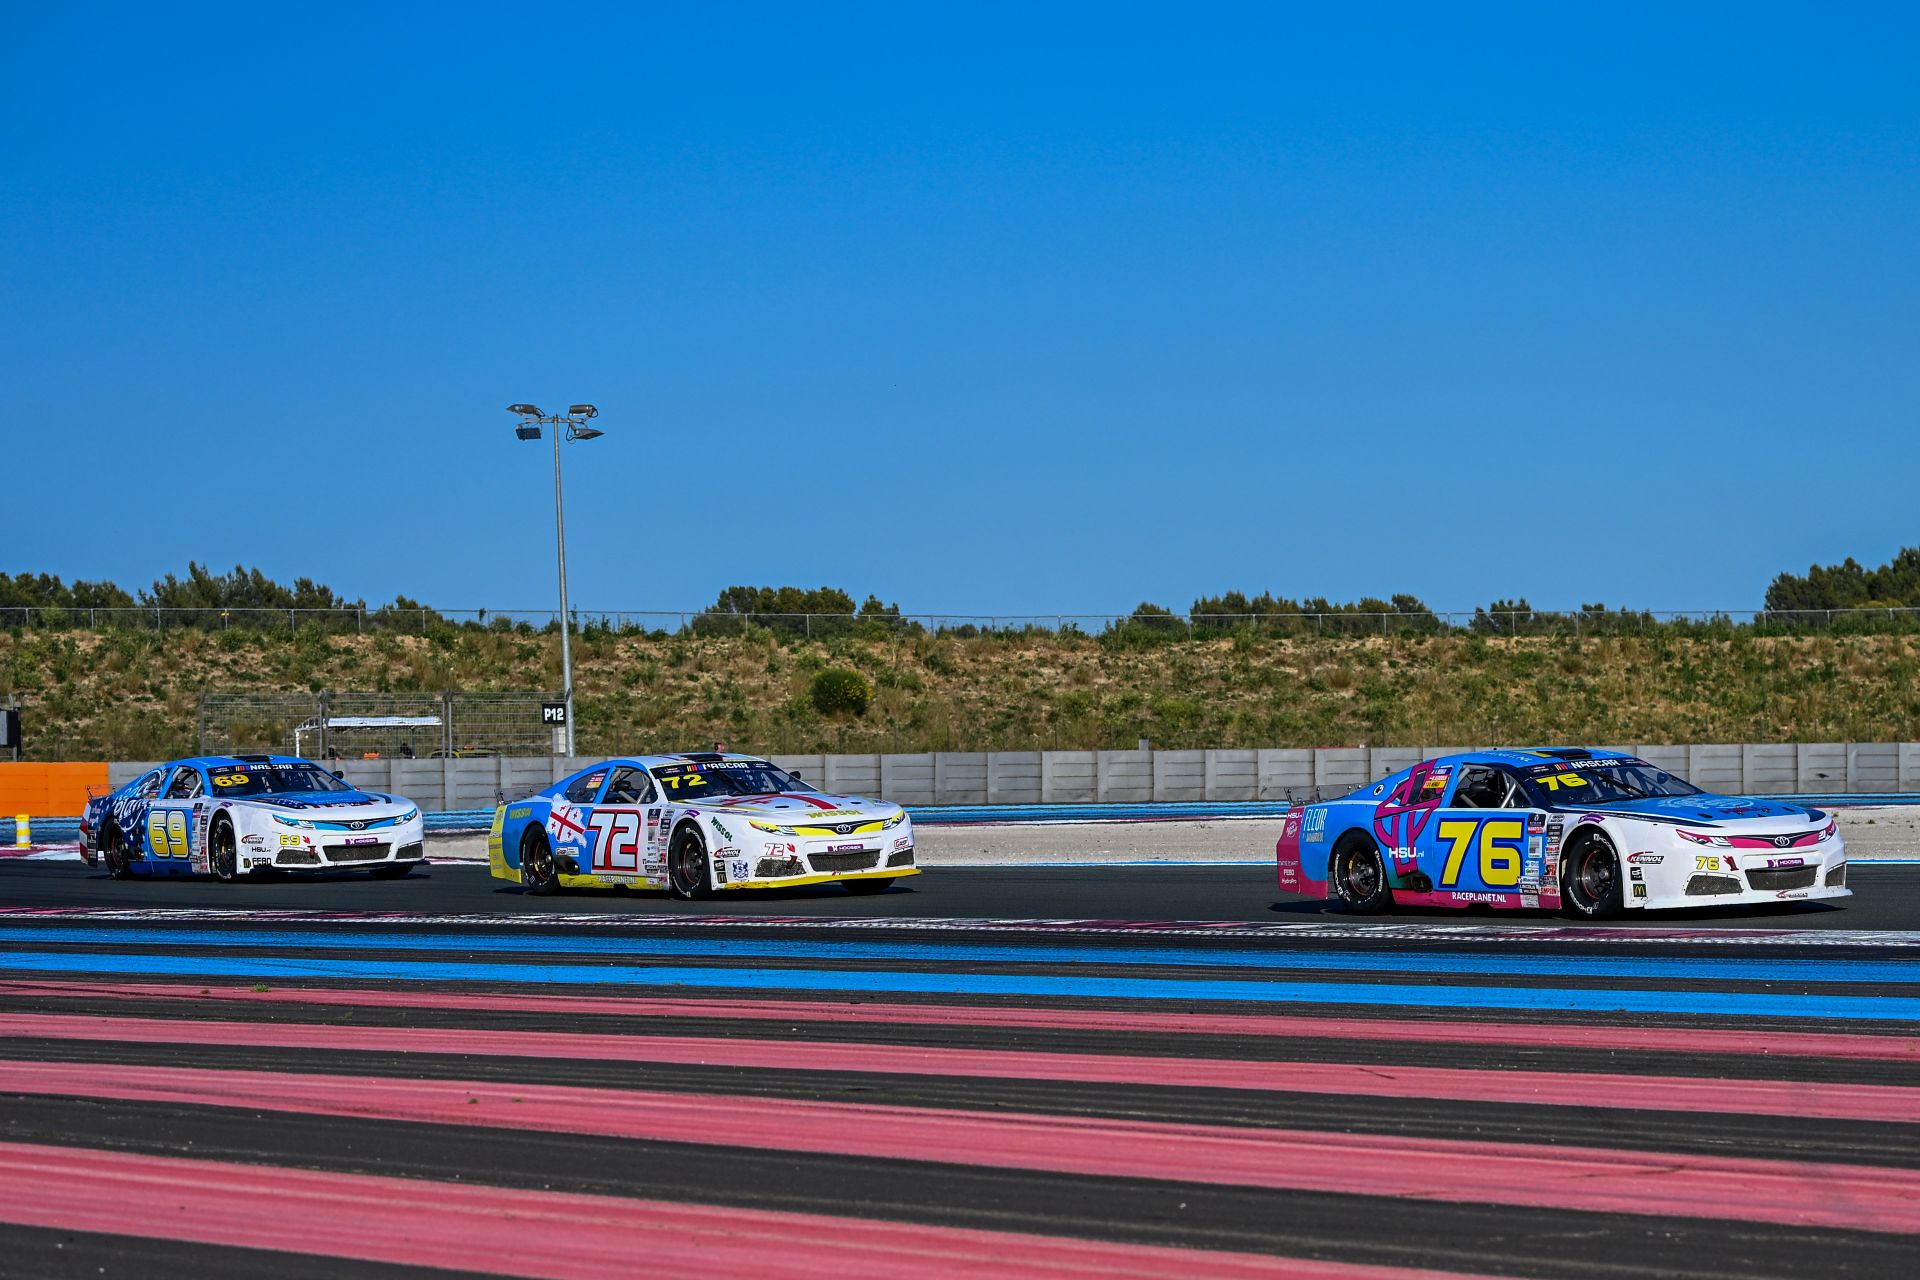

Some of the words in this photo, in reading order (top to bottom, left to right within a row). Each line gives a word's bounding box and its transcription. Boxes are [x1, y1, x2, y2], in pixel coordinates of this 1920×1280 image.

[544, 708, 564, 721] P12
[1571, 759, 1621, 769] NASCAR
[214, 774, 249, 787] 69
[661, 774, 707, 789] 72
[1535, 772, 1588, 791] 76
[806, 810, 864, 819] WISSOL
[1303, 808, 1328, 831] FLEUR
[148, 811, 189, 858] 69
[710, 816, 733, 843] WISSOL
[280, 835, 301, 846] 69
[587, 809, 641, 872] 72
[764, 842, 785, 857] 72
[1388, 847, 1425, 859] HSU.nl
[1438, 820, 1521, 886] 76
[1695, 856, 1720, 870] 76
[1451, 891, 1507, 903] RACEPLANET.NL
